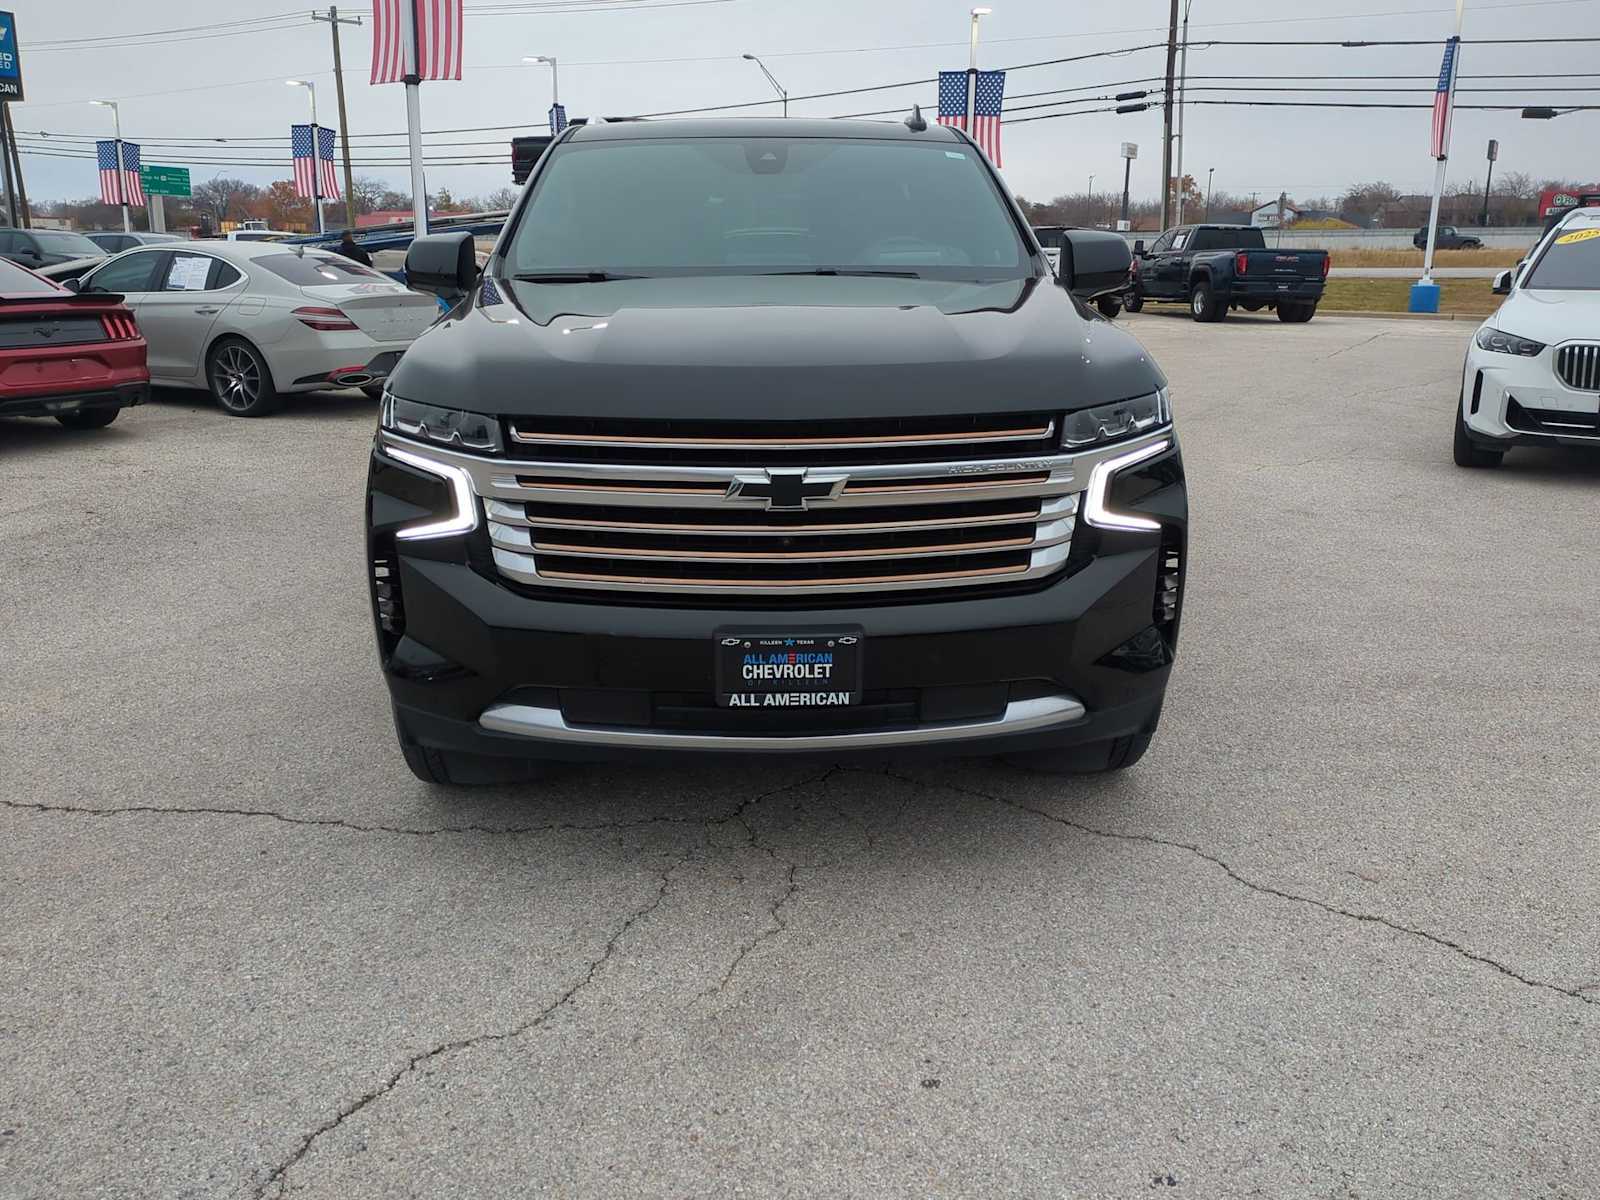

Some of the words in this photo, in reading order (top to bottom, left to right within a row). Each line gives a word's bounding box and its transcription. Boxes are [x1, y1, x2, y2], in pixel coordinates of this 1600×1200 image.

[988, 459, 1054, 471] COUNTRY
[743, 654, 767, 664] ALL
[769, 653, 833, 664] AMERICAN
[742, 664, 833, 679] CHEVROLET
[729, 693, 760, 706] ALL
[763, 692, 850, 706] AMERICAN
